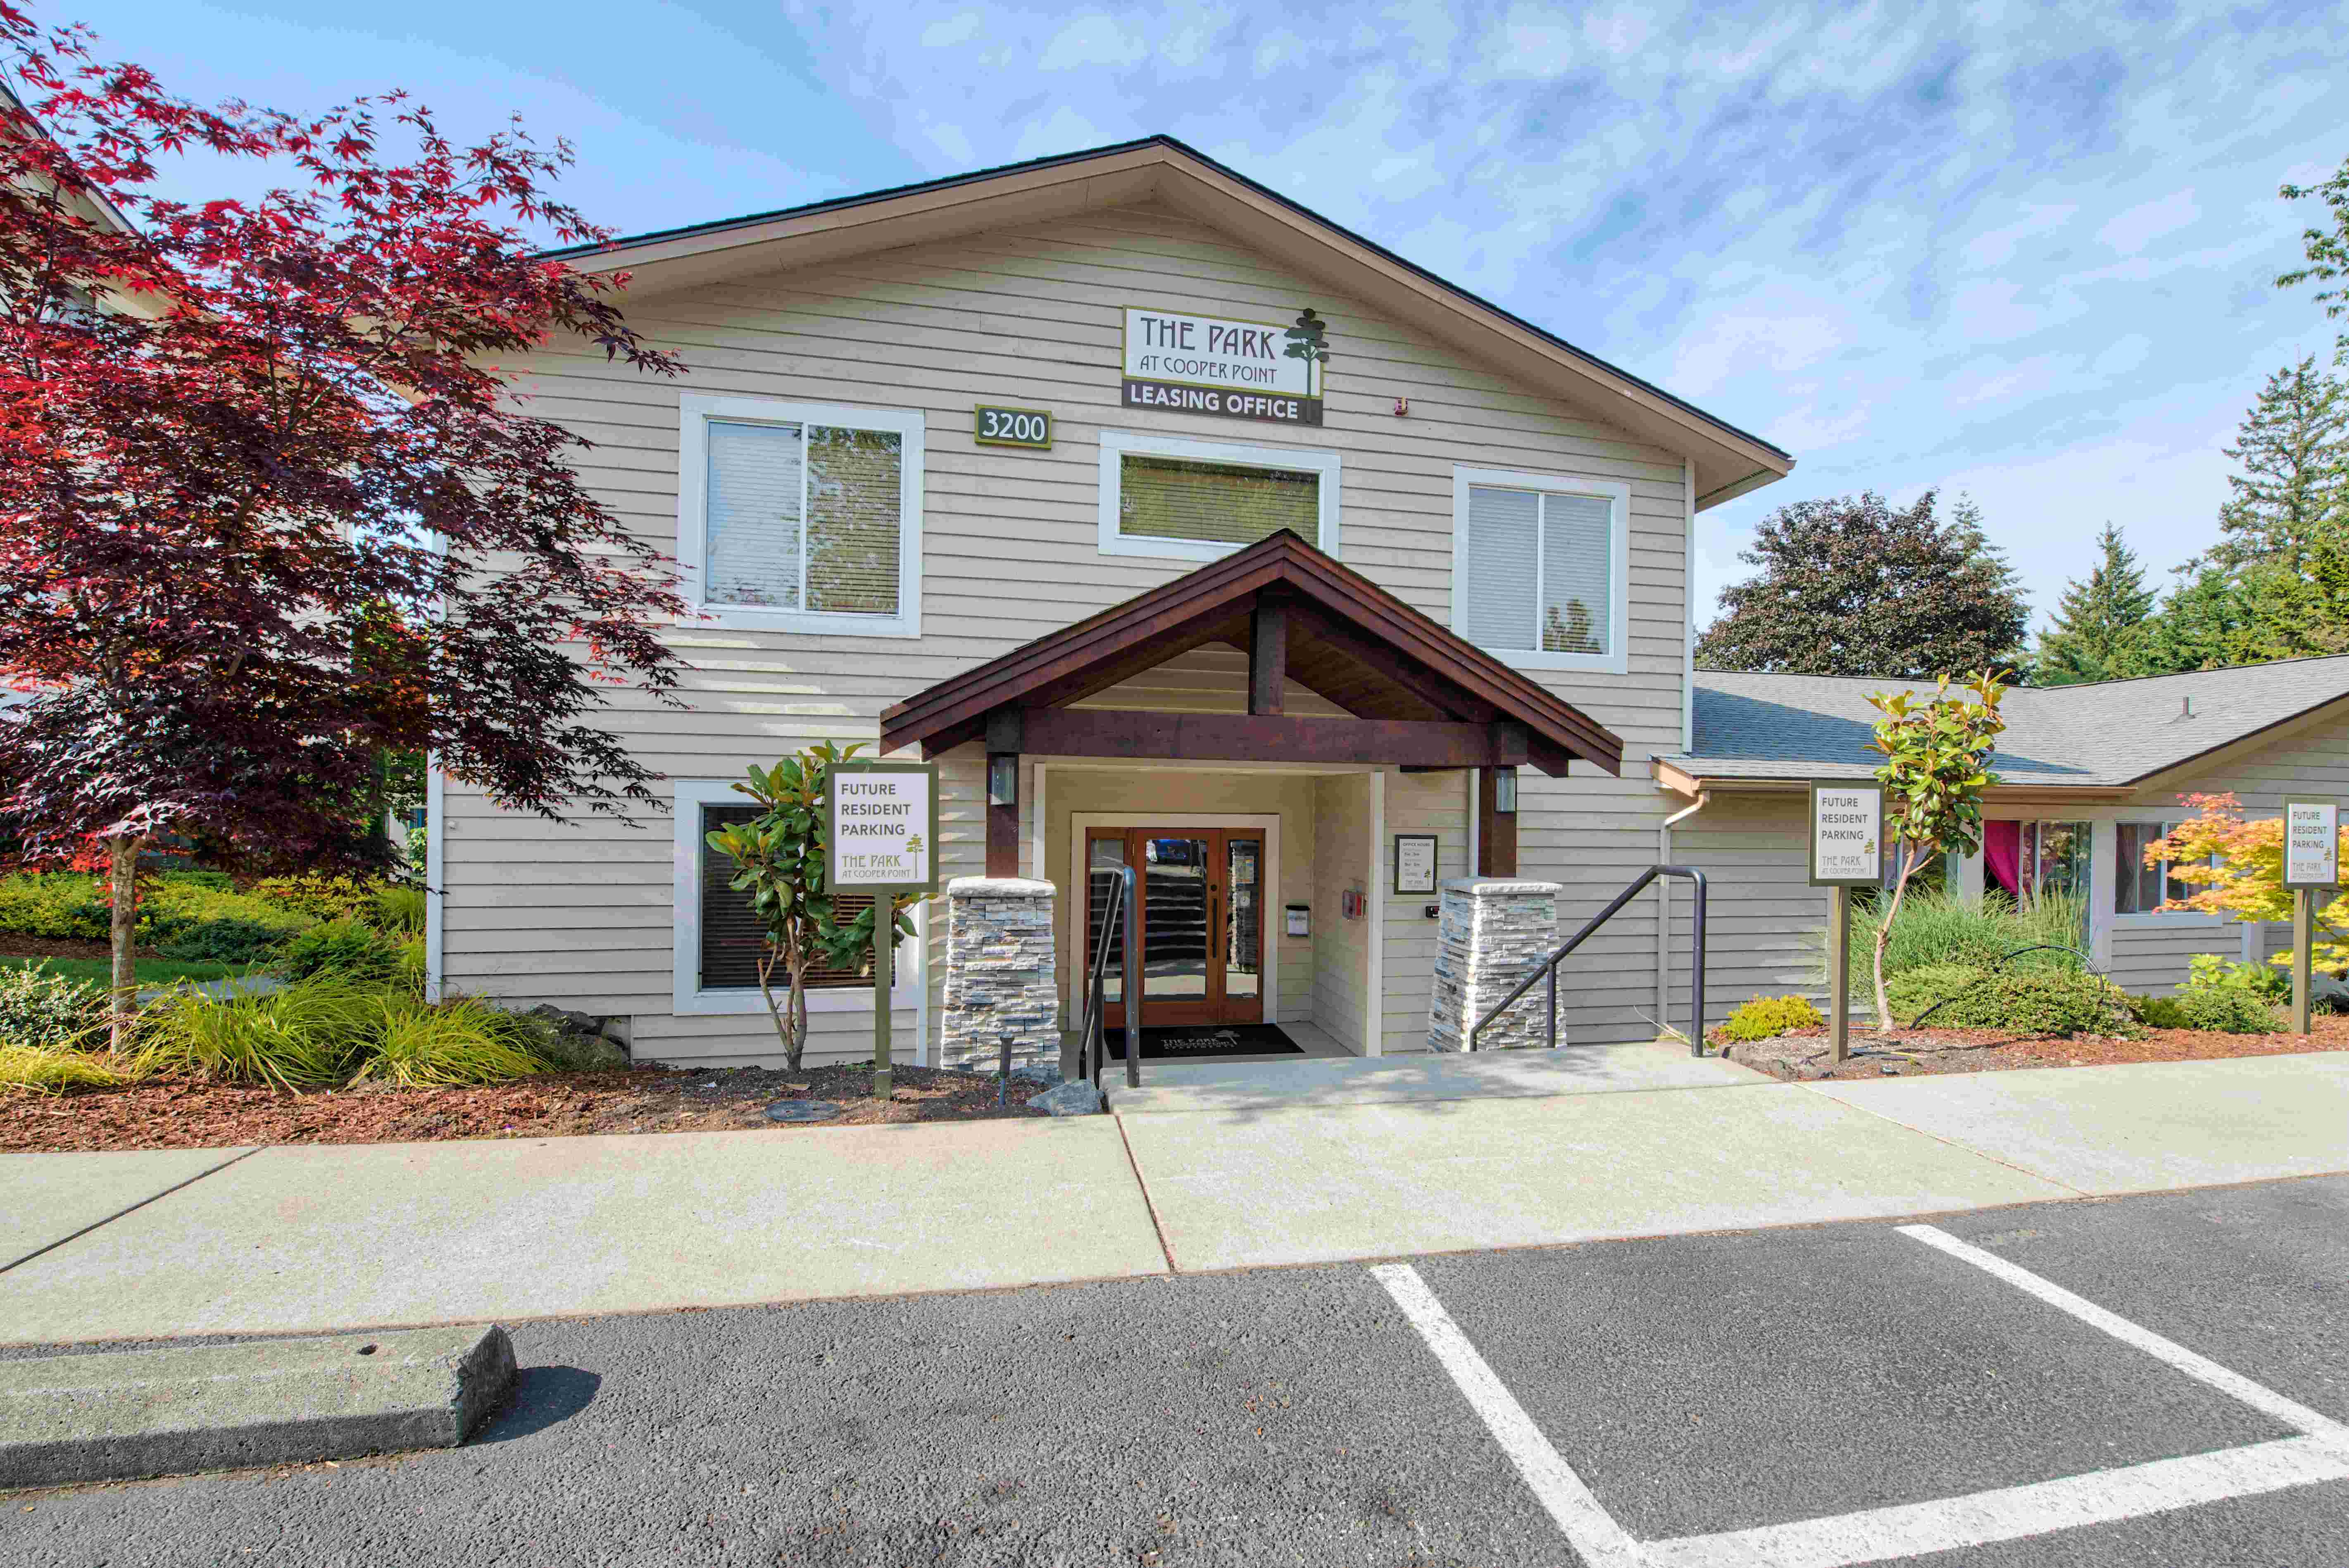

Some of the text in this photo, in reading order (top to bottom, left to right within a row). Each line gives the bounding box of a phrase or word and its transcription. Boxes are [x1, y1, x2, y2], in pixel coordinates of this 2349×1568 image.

[1140, 317, 1276, 359] THE PARK
[1140, 355, 1277, 383] AT COOPER POINT
[1130, 384, 1298, 419] LEASING OFFICE
[982, 412, 1045, 441] 3200
[841, 784, 896, 795] FUTURE
[1822, 797, 1858, 807] FUTURE
[841, 804, 911, 815] RESIDENT
[1822, 814, 1868, 823] RESIDENT
[2293, 811, 2320, 820] FUTURE
[841, 824, 905, 835] PARKING
[2293, 826, 2327, 834] RESIDENT
[1822, 830, 1863, 840] PARKING
[2292, 840, 2324, 849] PARKING
[842, 855, 901, 867] THE PARK
[1822, 856, 1861, 866] THE PARK
[2293, 863, 2304, 872] THE
[842, 869, 911, 878] AT COOPER POINT
